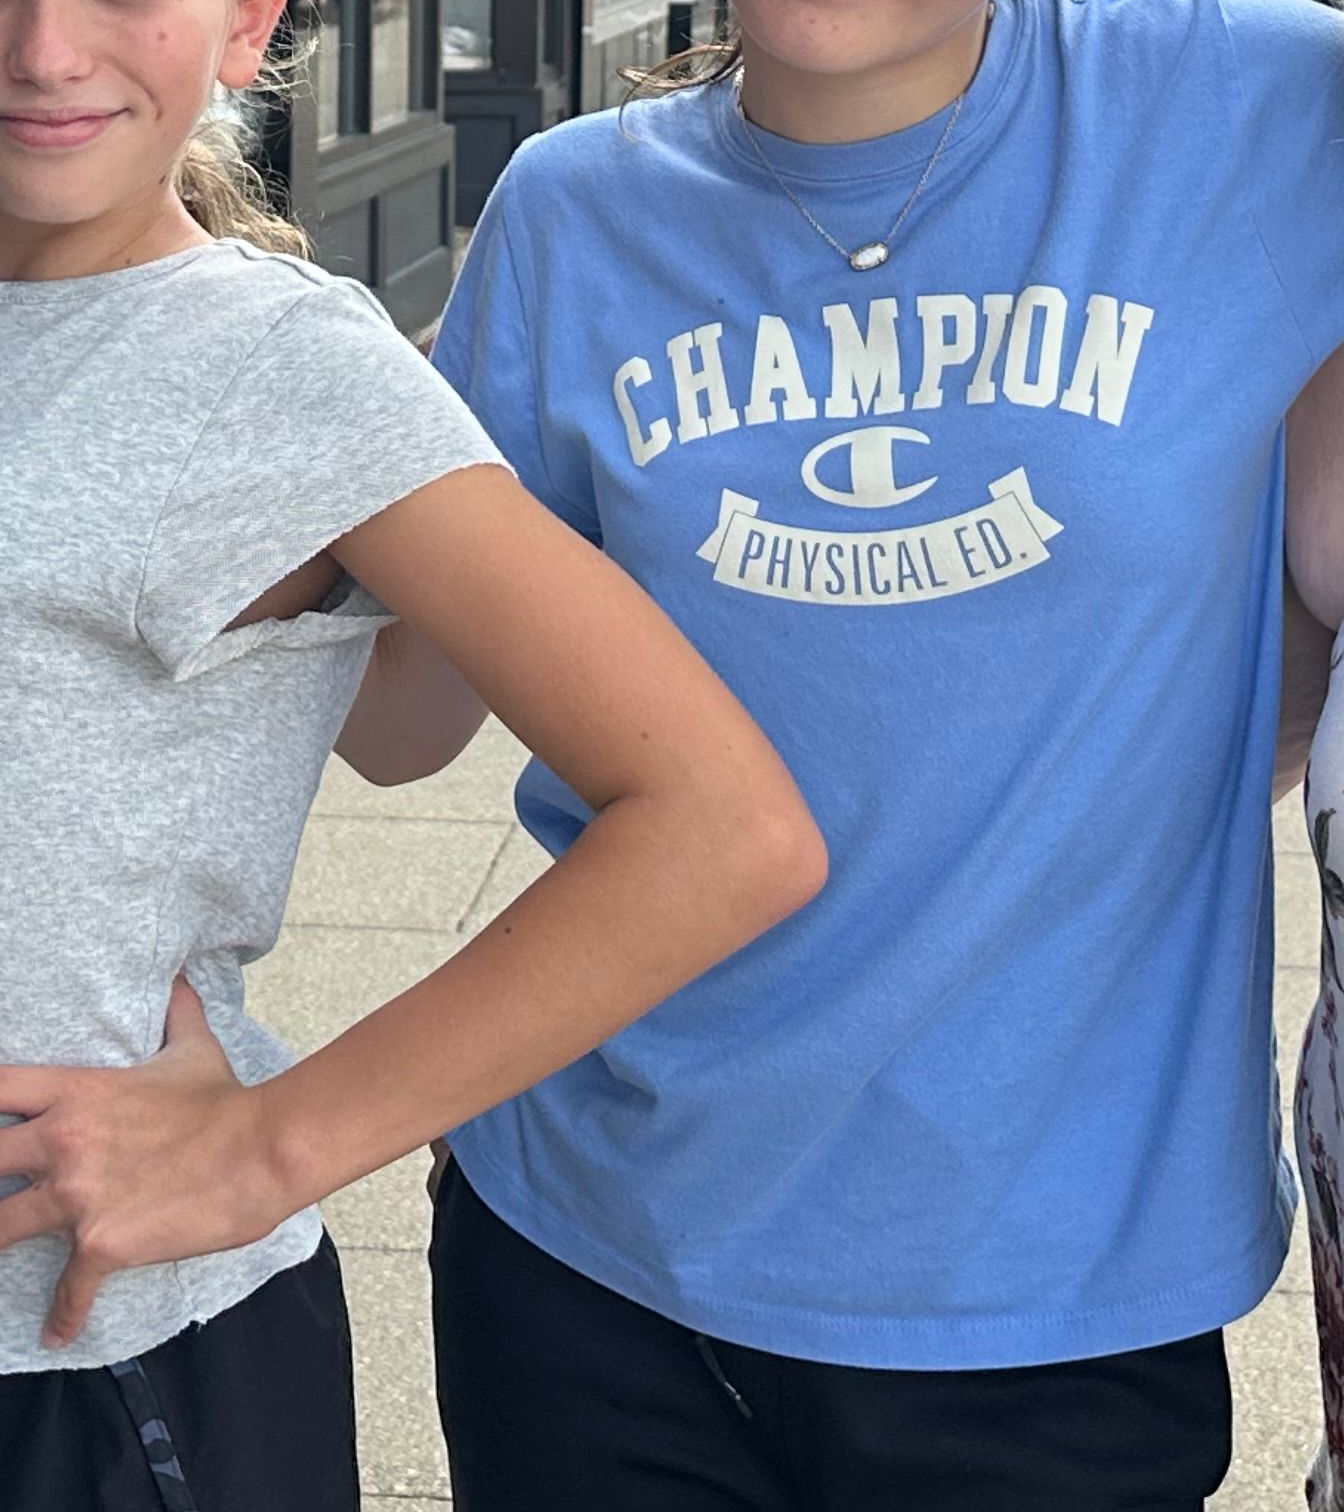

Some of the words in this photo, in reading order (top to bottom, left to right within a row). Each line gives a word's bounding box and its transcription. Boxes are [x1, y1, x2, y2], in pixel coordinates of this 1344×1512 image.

[613, 284, 1155, 467] CHAMPION
[736, 530, 948, 598] PHYSICAL
[953, 516, 1028, 578] ED.
